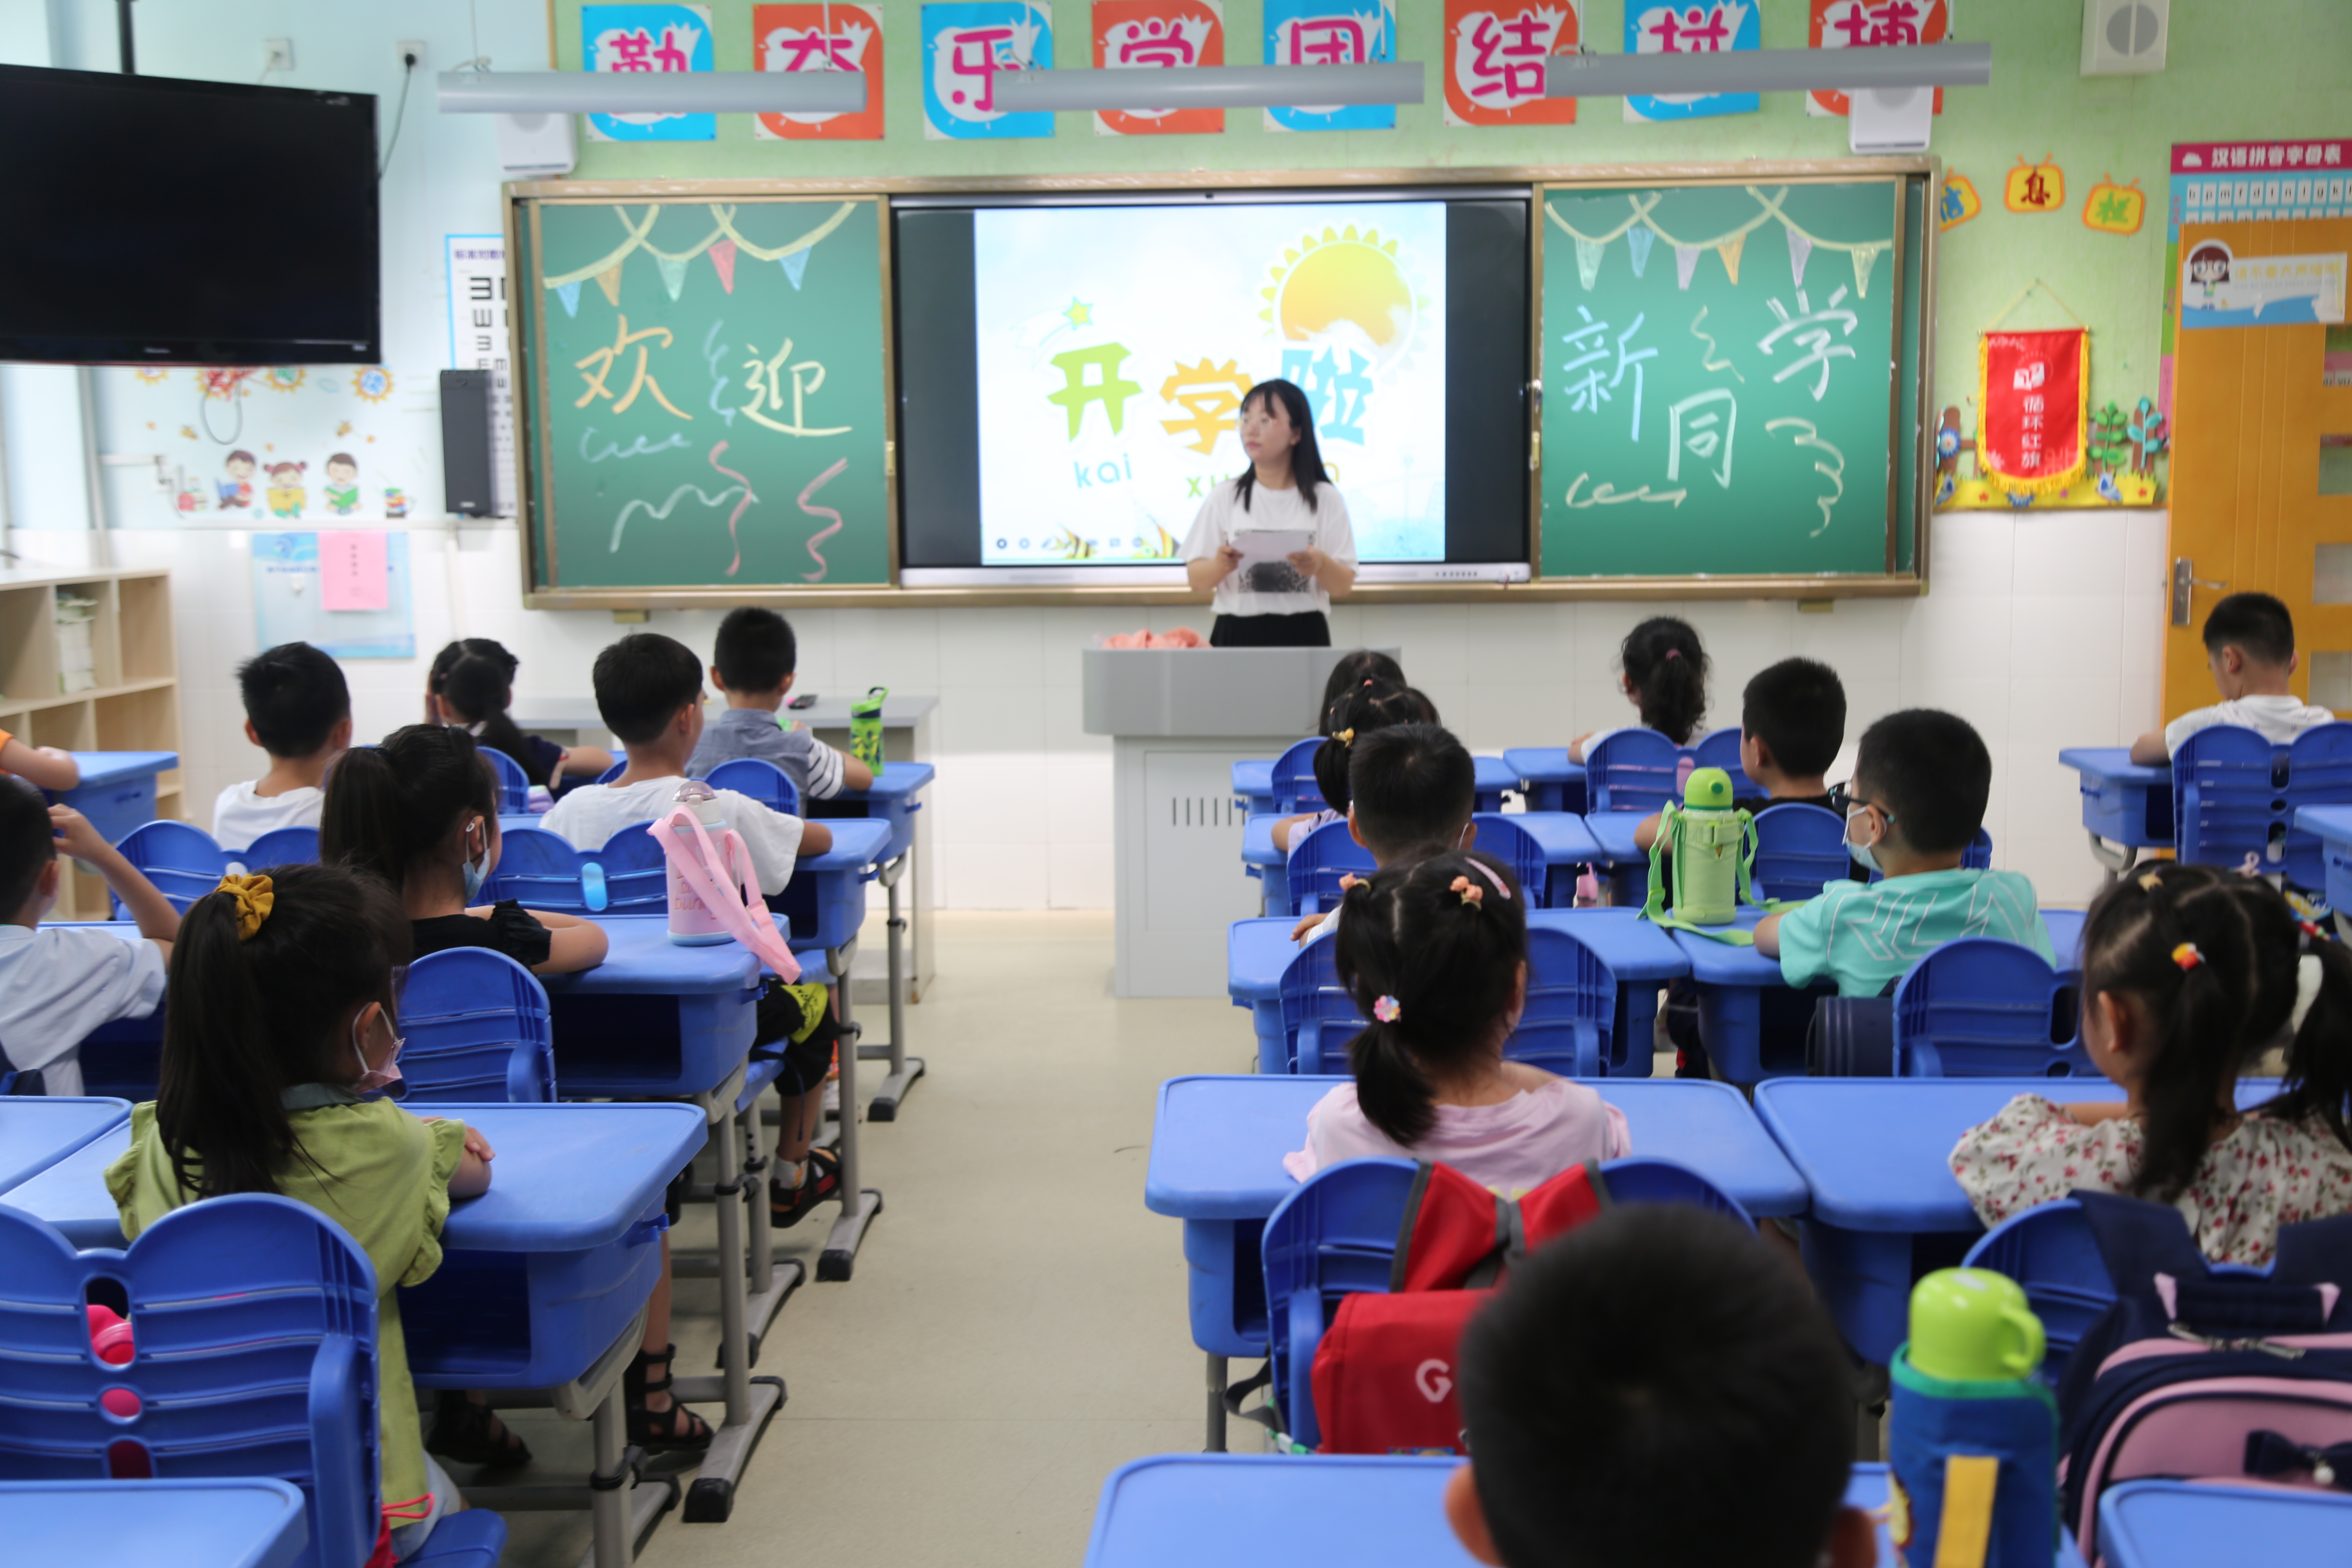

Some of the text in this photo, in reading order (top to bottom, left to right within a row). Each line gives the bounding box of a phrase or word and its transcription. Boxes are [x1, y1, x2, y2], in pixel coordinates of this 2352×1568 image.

[2211, 143, 2341, 169] 汉语拼音字母表
[573, 313, 853, 438] 欢迎
[1046, 341, 1374, 456] 开学啦
[1074, 453, 1133, 489] kai
